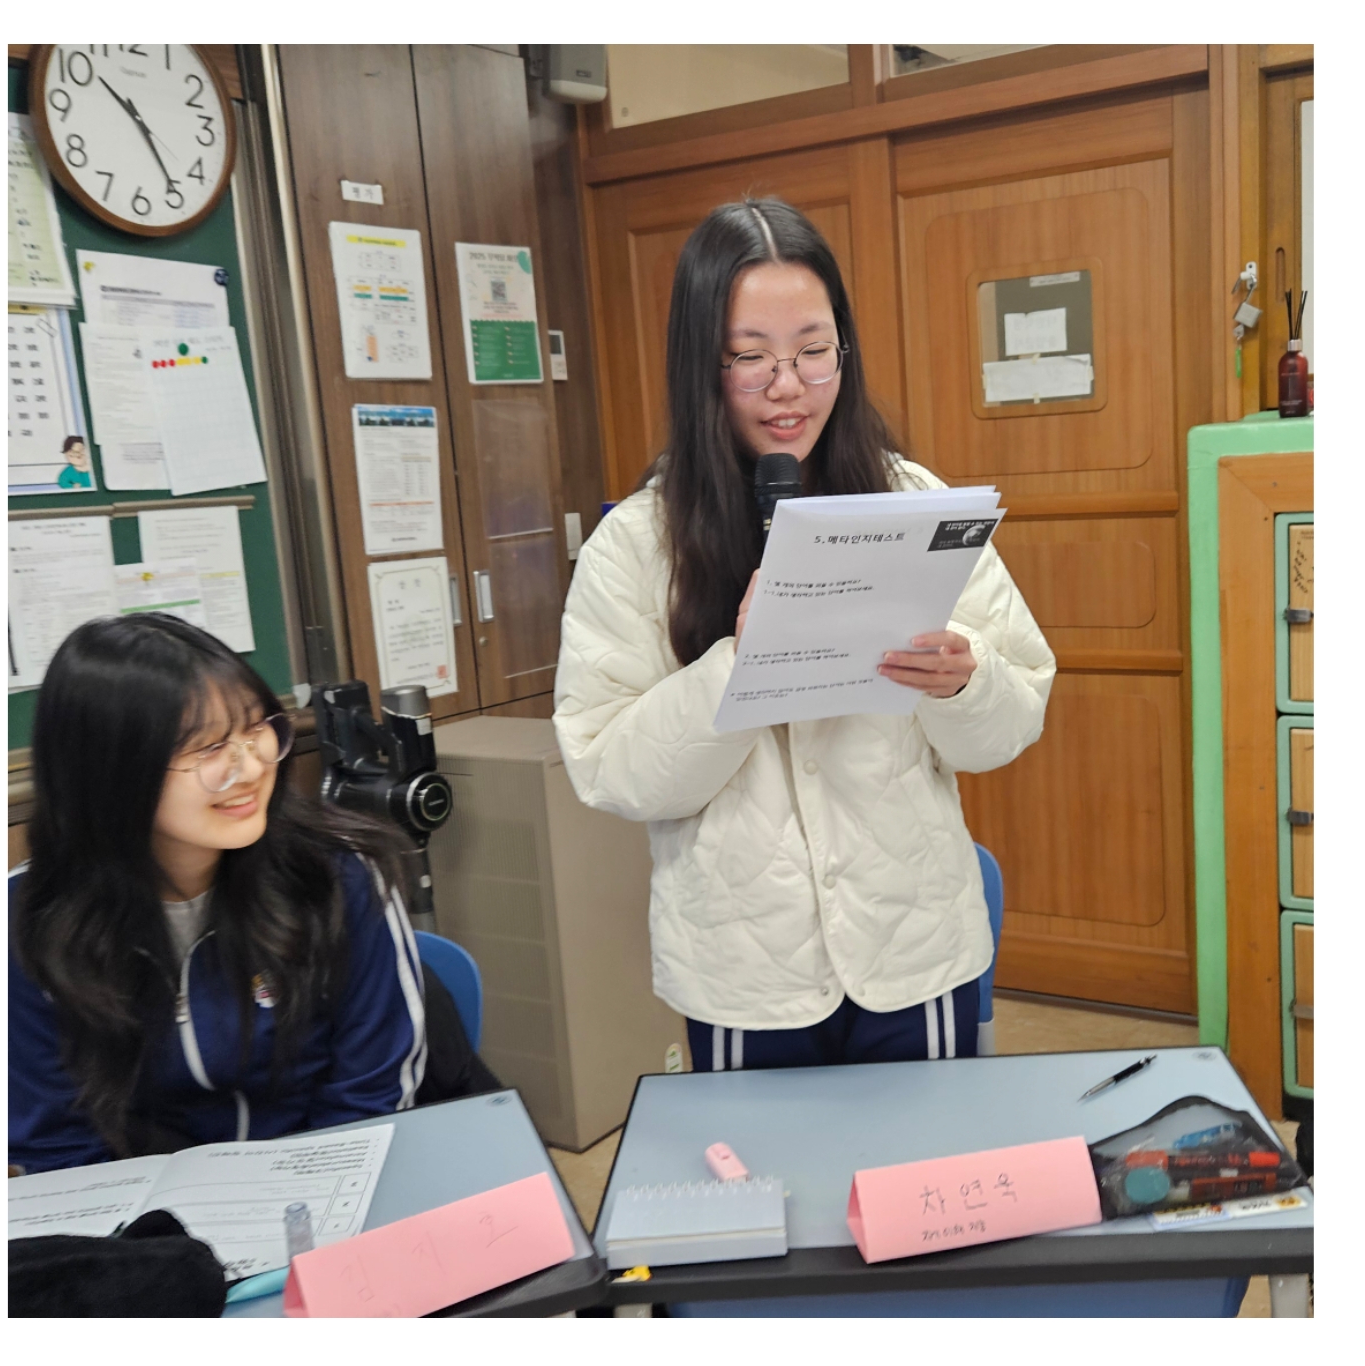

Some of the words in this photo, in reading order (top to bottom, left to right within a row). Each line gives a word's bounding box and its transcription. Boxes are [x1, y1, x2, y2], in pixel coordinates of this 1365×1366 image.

[57, 51, 93, 87] 10
[49, 88, 72, 122] 9
[183, 75, 204, 108] 2
[195, 114, 216, 147] 3
[65, 134, 88, 168] 8
[96, 172, 115, 201] 7
[187, 158, 205, 185] 4
[131, 186, 151, 216] 6
[165, 182, 185, 210] 5
